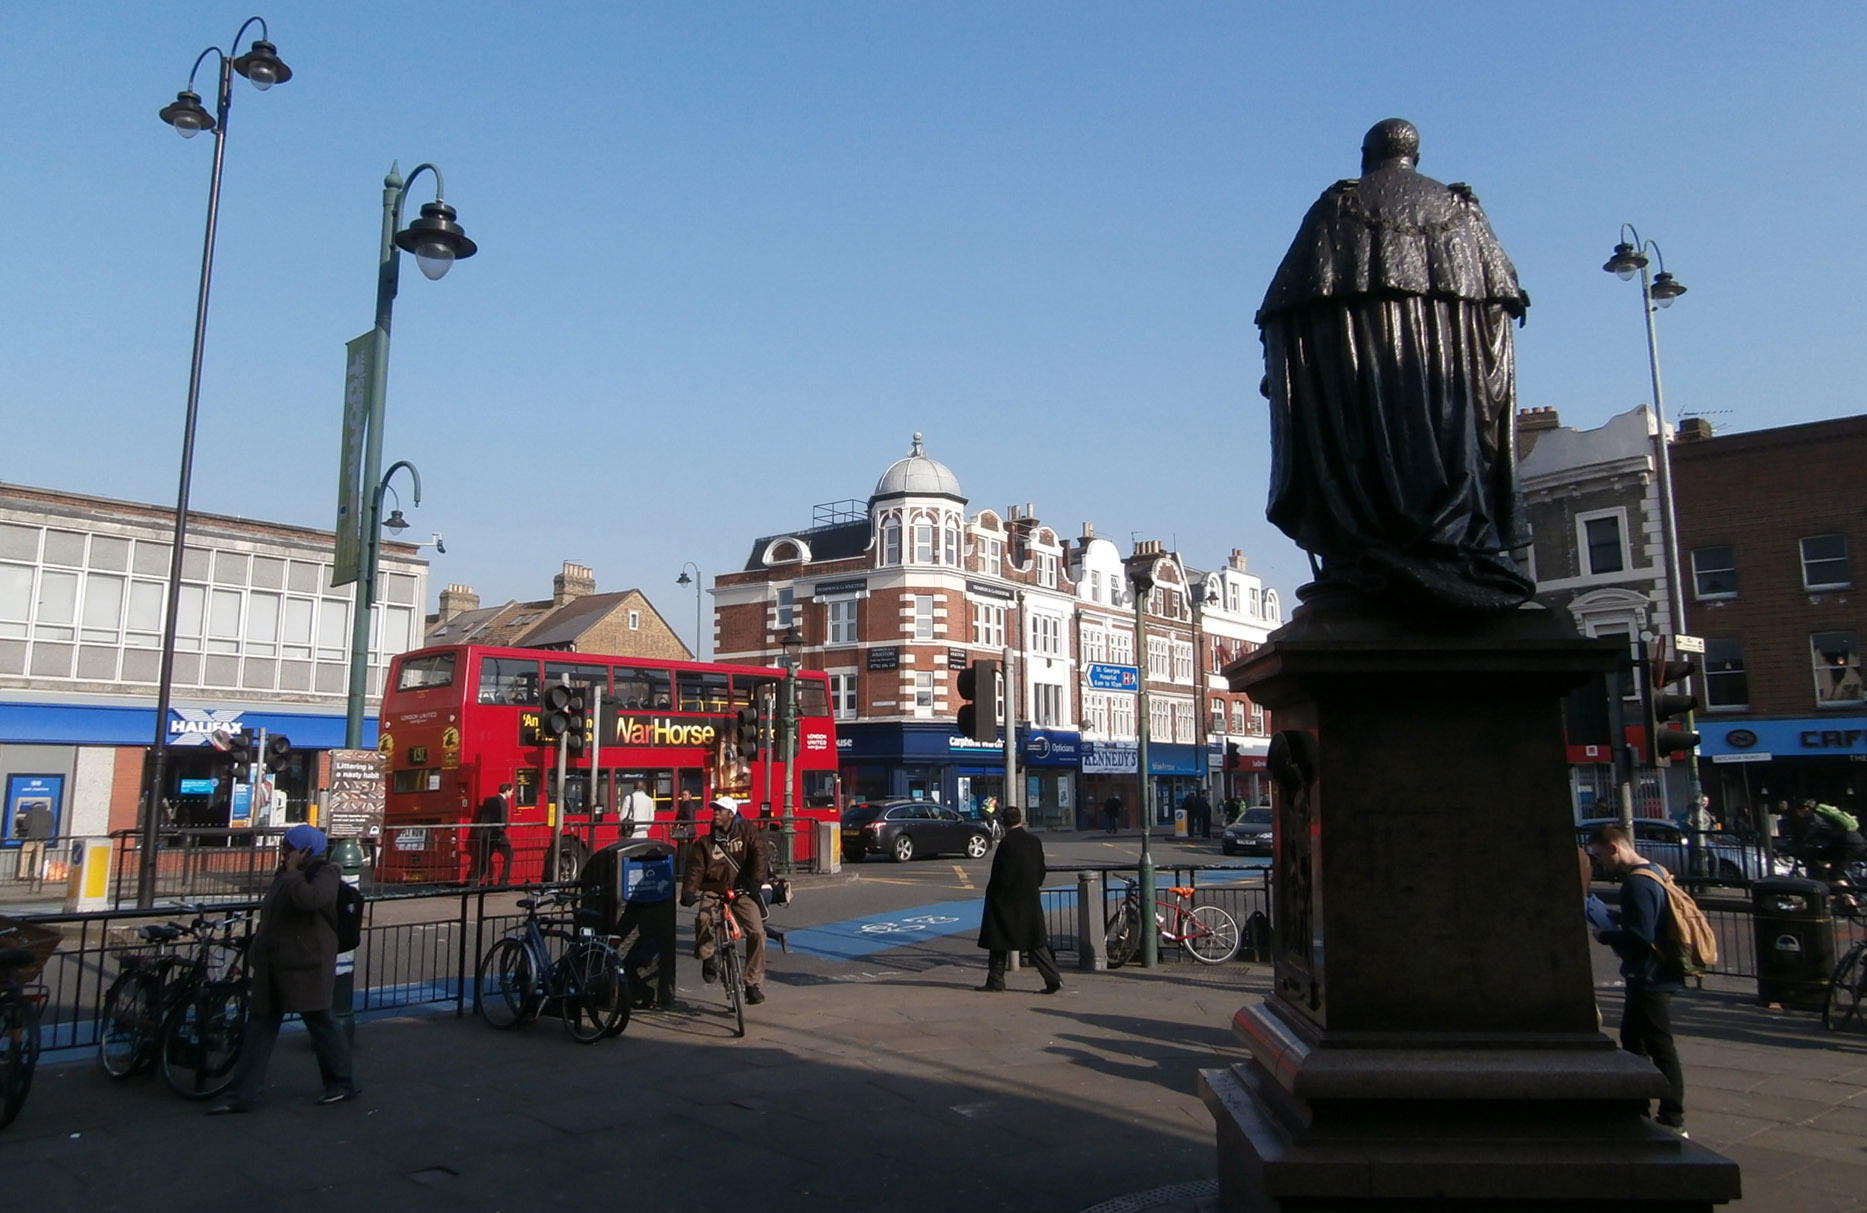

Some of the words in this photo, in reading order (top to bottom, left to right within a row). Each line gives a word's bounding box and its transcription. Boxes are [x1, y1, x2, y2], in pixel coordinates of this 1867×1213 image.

[170, 720, 243, 735] HALIFAX
[1051, 743, 1075, 753] Opticians
[336, 762, 366, 771] Littering
